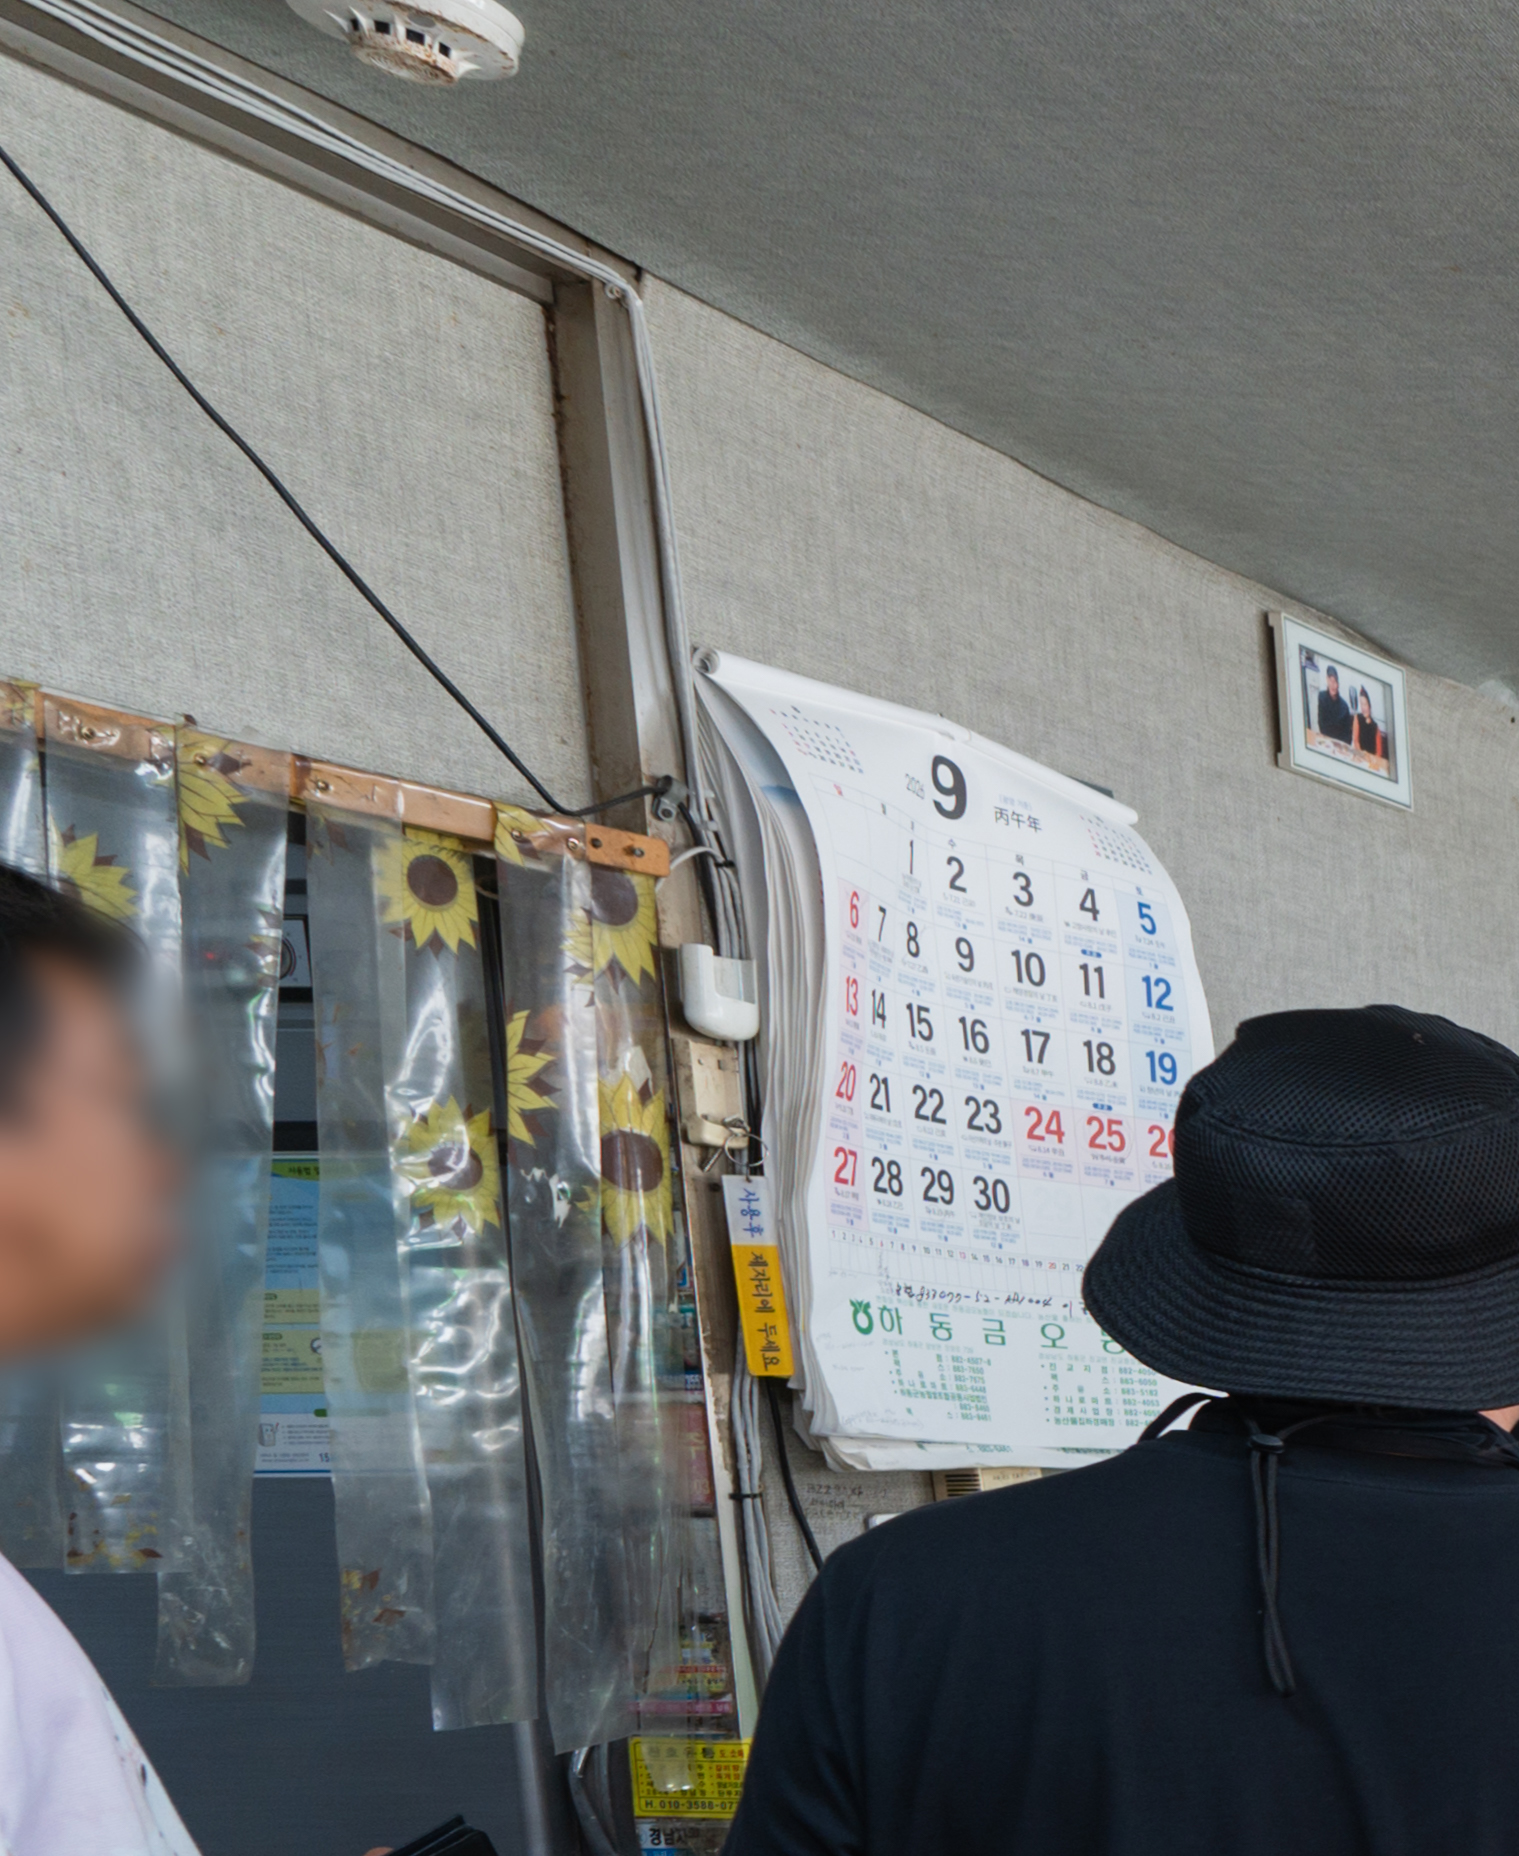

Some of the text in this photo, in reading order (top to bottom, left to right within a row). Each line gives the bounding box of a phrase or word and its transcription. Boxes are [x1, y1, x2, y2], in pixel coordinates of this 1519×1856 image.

[905, 753, 1043, 833] 2026 9 丙午年
[909, 840, 1157, 935] 1 2 3 4 5
[849, 890, 1174, 1012] 6 7 8 9 10 11 12
[845, 975, 1177, 1086] 13 14 15 16 17 18 19
[835, 1060, 1176, 1159] 20 21 22 23 24 25 2
[833, 1146, 1010, 1214] 27 28 29 30
[748, 1251, 781, 1371] 제자리에 두세요
